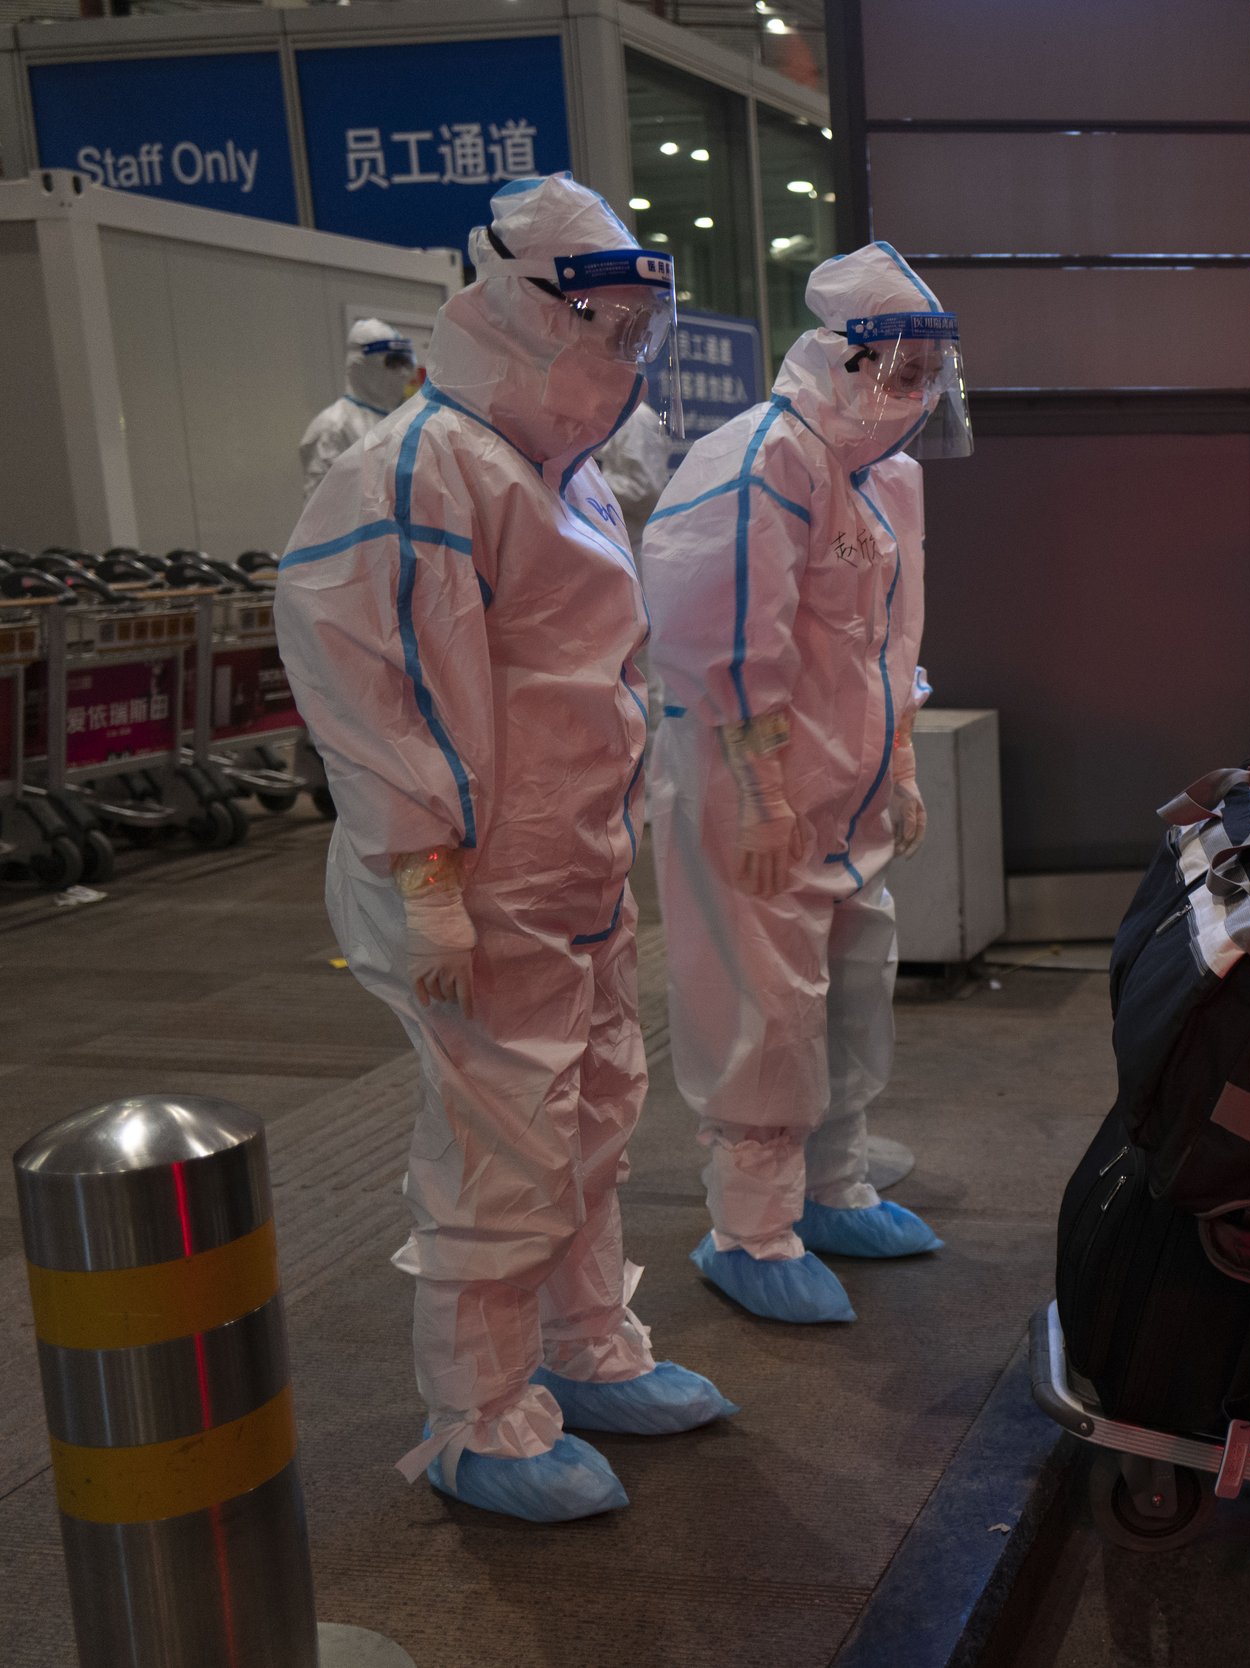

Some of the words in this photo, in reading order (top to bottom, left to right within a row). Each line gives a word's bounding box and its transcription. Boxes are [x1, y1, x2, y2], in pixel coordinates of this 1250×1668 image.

[77, 143, 163, 189] Staff
[171, 139, 259, 192] Only
[345, 118, 538, 192] 员工通道
